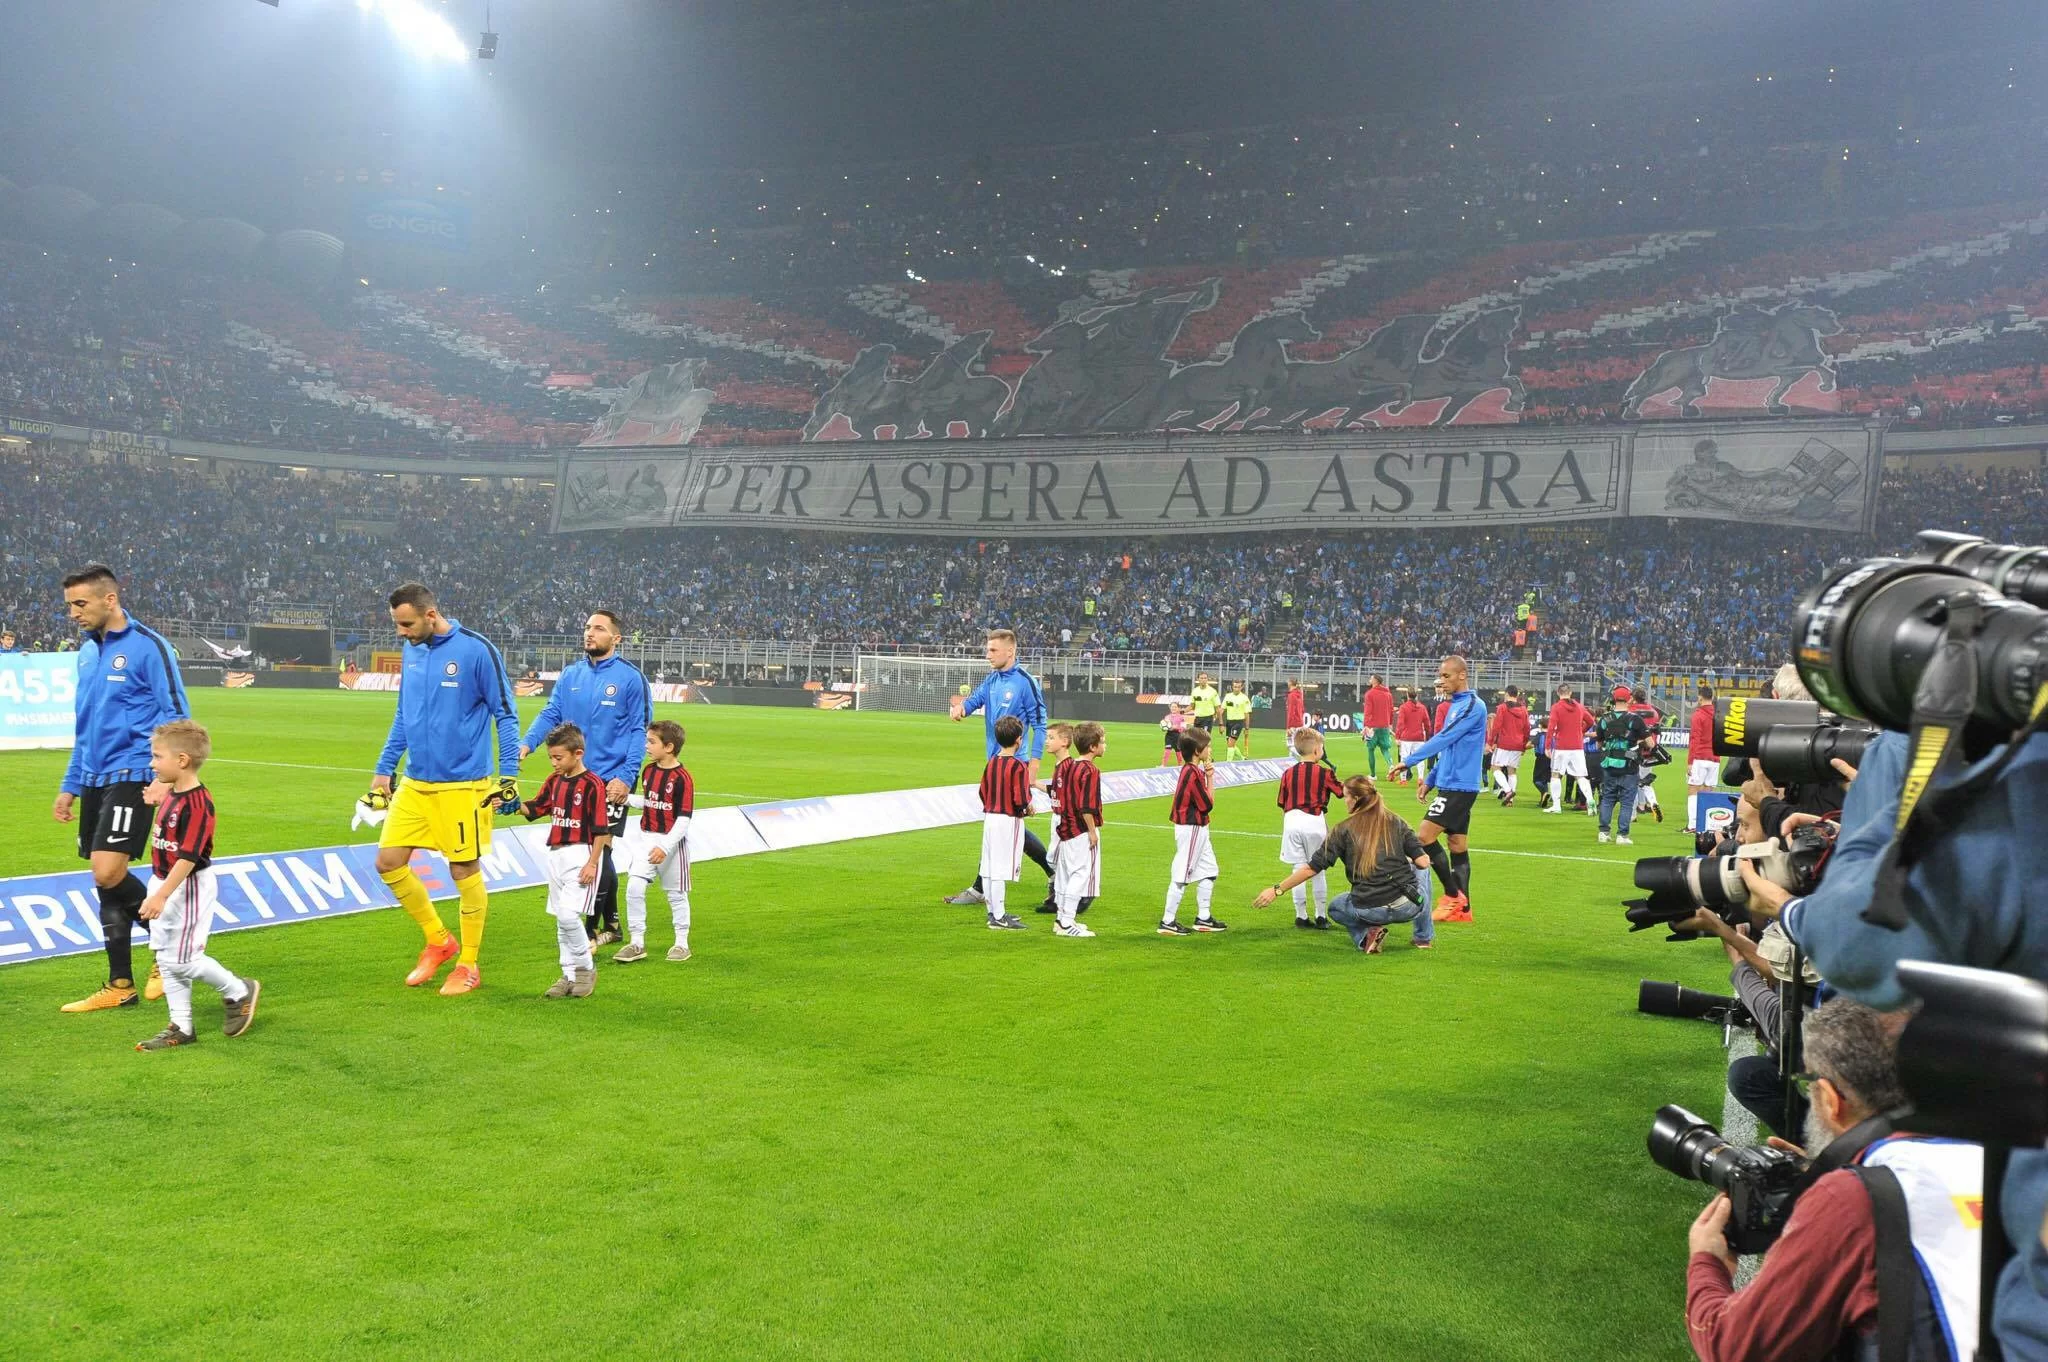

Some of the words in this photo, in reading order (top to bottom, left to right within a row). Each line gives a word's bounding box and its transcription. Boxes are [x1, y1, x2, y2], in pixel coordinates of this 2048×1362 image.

[105, 431, 154, 449] MOLE
[693, 461, 811, 517] PER
[841, 459, 1125, 522] ASPERA
[1156, 454, 1271, 519] AD
[1301, 447, 1598, 514] ASTRA
[1650, 676, 1690, 687] INTER
[111, 805, 134, 833] 11
[552, 806, 566, 818] Fly
[457, 821, 465, 845] 1
[206, 852, 372, 920] TIM
